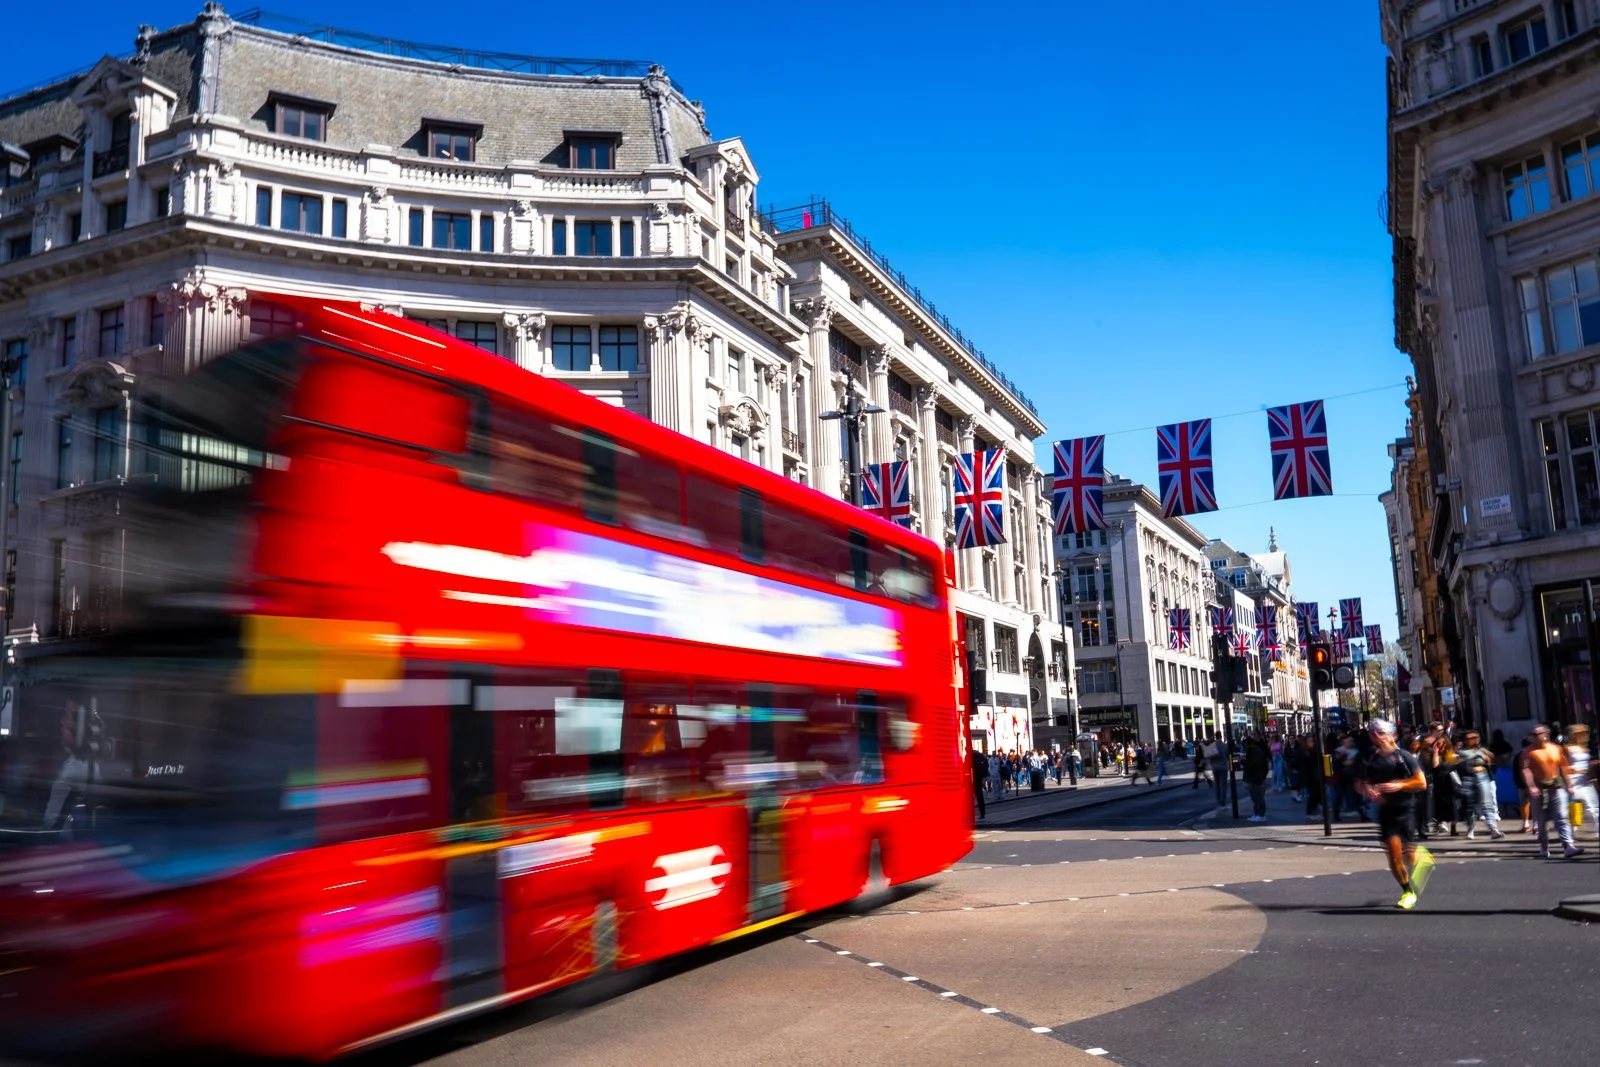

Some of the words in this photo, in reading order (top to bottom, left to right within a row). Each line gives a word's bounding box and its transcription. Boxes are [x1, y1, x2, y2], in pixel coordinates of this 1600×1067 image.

[145, 765, 164, 778] Just
[164, 764, 177, 775] Do
[177, 764, 185, 774] It
